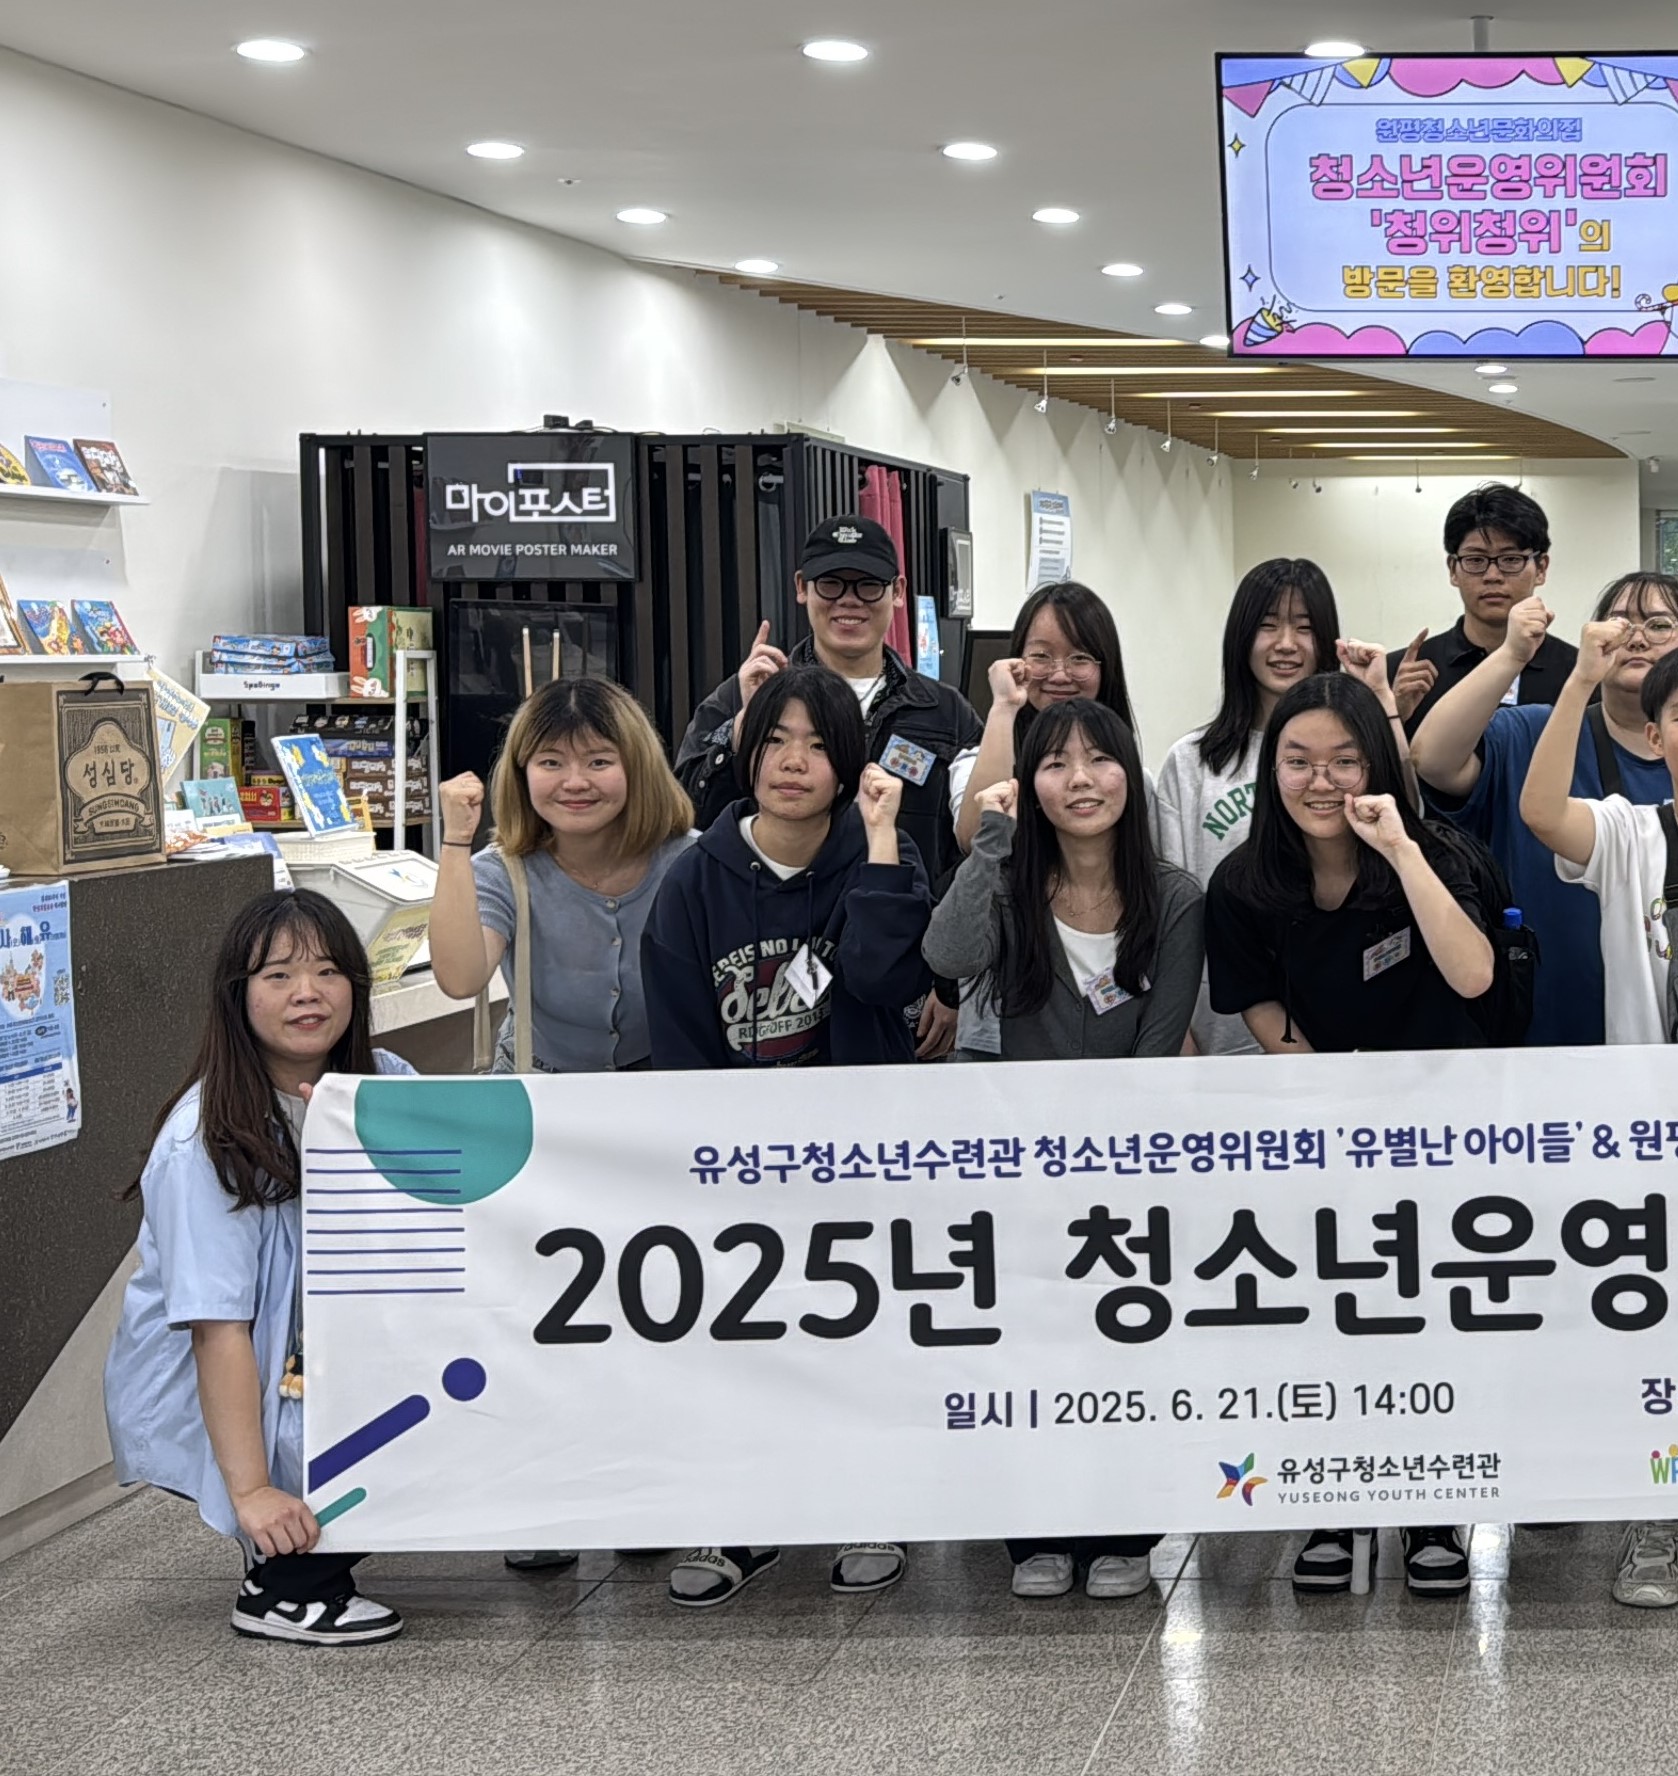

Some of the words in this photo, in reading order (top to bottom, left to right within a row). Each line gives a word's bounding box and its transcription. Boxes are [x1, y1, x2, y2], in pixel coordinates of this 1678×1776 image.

[1376, 117, 1582, 142] 원평청소년문화의집
[1309, 153, 1667, 200] 청소년운영위원회
[1342, 264, 1438, 298] 방문을
[1448, 264, 1621, 299] 환영합니다!
[446, 463, 616, 522] 마이포스터
[447, 544, 466, 556] AR
[469, 544, 512, 556] MOVIE
[516, 544, 567, 556] POSTER
[570, 544, 618, 556] MAKER
[82, 758, 135, 788] 성심당
[689, 1137, 1026, 1185] 유성구청소년수련관
[1034, 1128, 1325, 1177] 청소년운영위원회
[1337, 1125, 1457, 1168] '유별난
[1464, 1121, 1582, 1164] 아이들'
[1592, 1124, 1621, 1159] &
[533, 1210, 1002, 1347] 2025년
[1055, 1390, 1156, 1424] 2025.
[1172, 1389, 1203, 1421] 6.
[1218, 1381, 1336, 1422] 21.(토)
[1354, 1382, 1454, 1416] 14:00
[1277, 1452, 1501, 1484] 유성구청소년수련관
[1278, 1491, 1359, 1505] YUSEONG
[1367, 1489, 1427, 1502] YOUTH
[1433, 1486, 1500, 1500] CENTER
